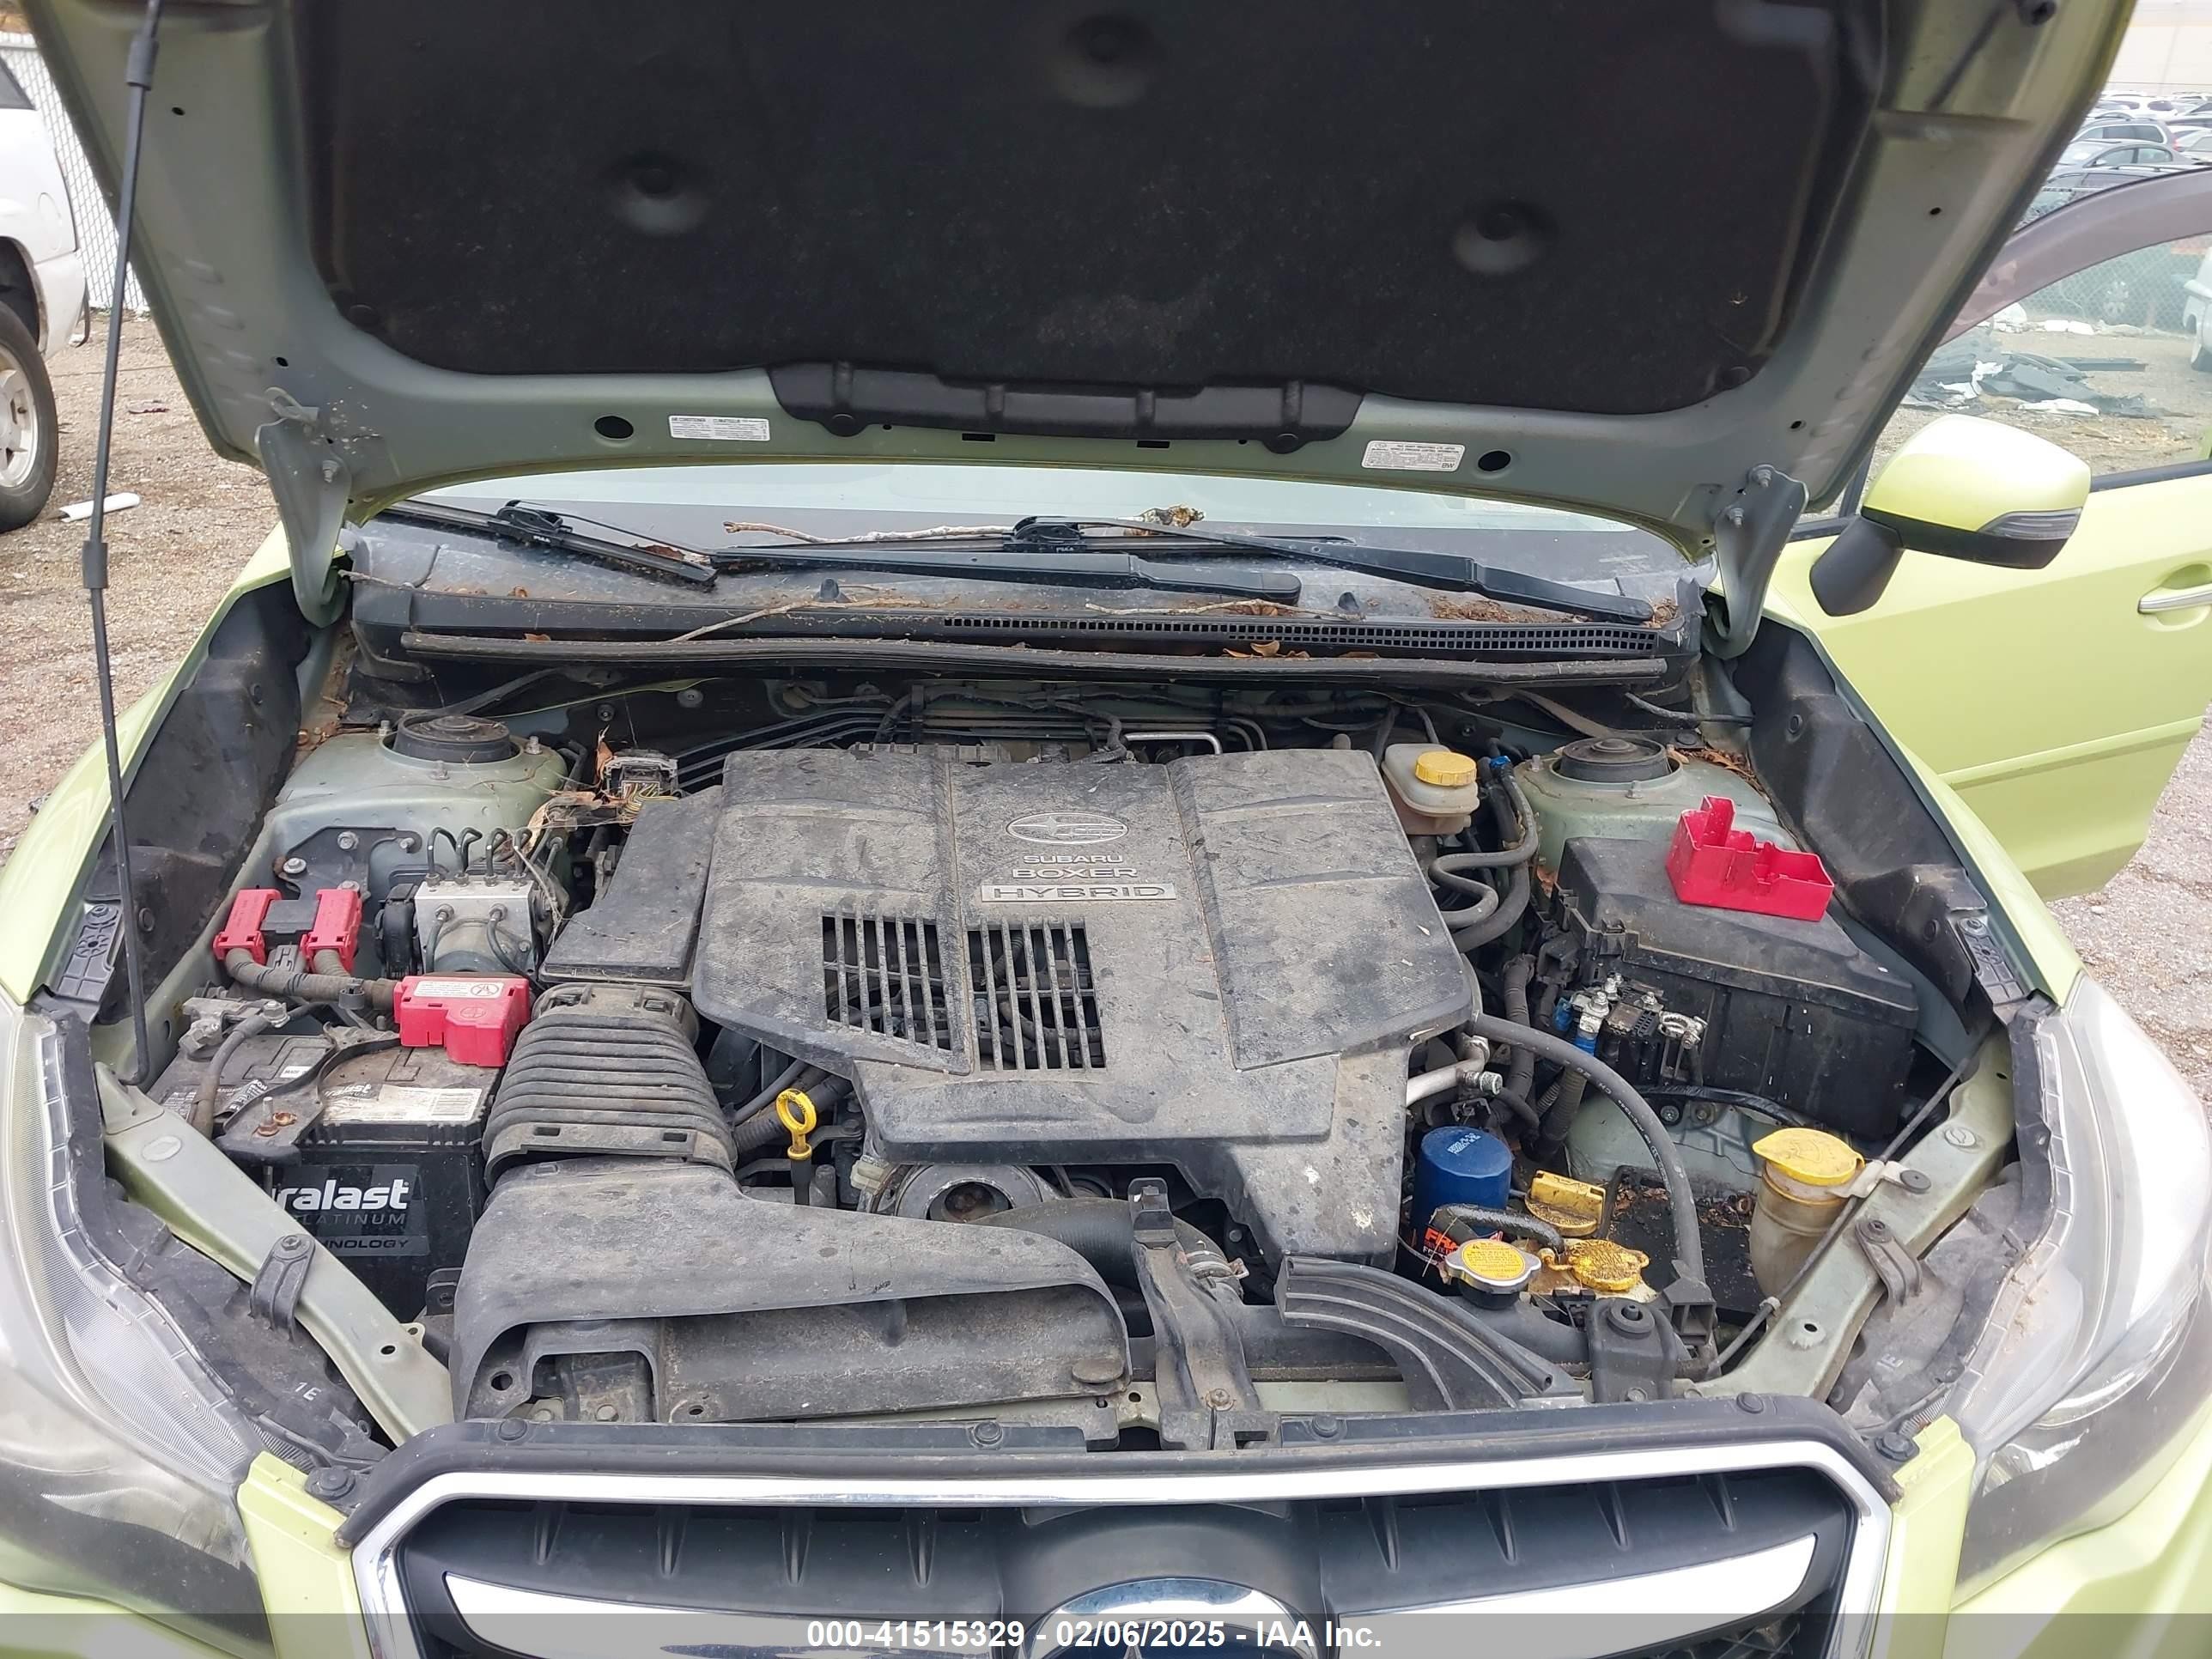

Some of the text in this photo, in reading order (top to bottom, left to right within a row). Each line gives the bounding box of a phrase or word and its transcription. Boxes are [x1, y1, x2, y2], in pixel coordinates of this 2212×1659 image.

[1023, 854, 1124, 865] SUBARU
[1012, 867, 1139, 879] BOXER
[993, 886, 1166, 899] HYBRID
[272, 1179, 410, 1211] ralast
[295, 1213, 405, 1225] LATINUM
